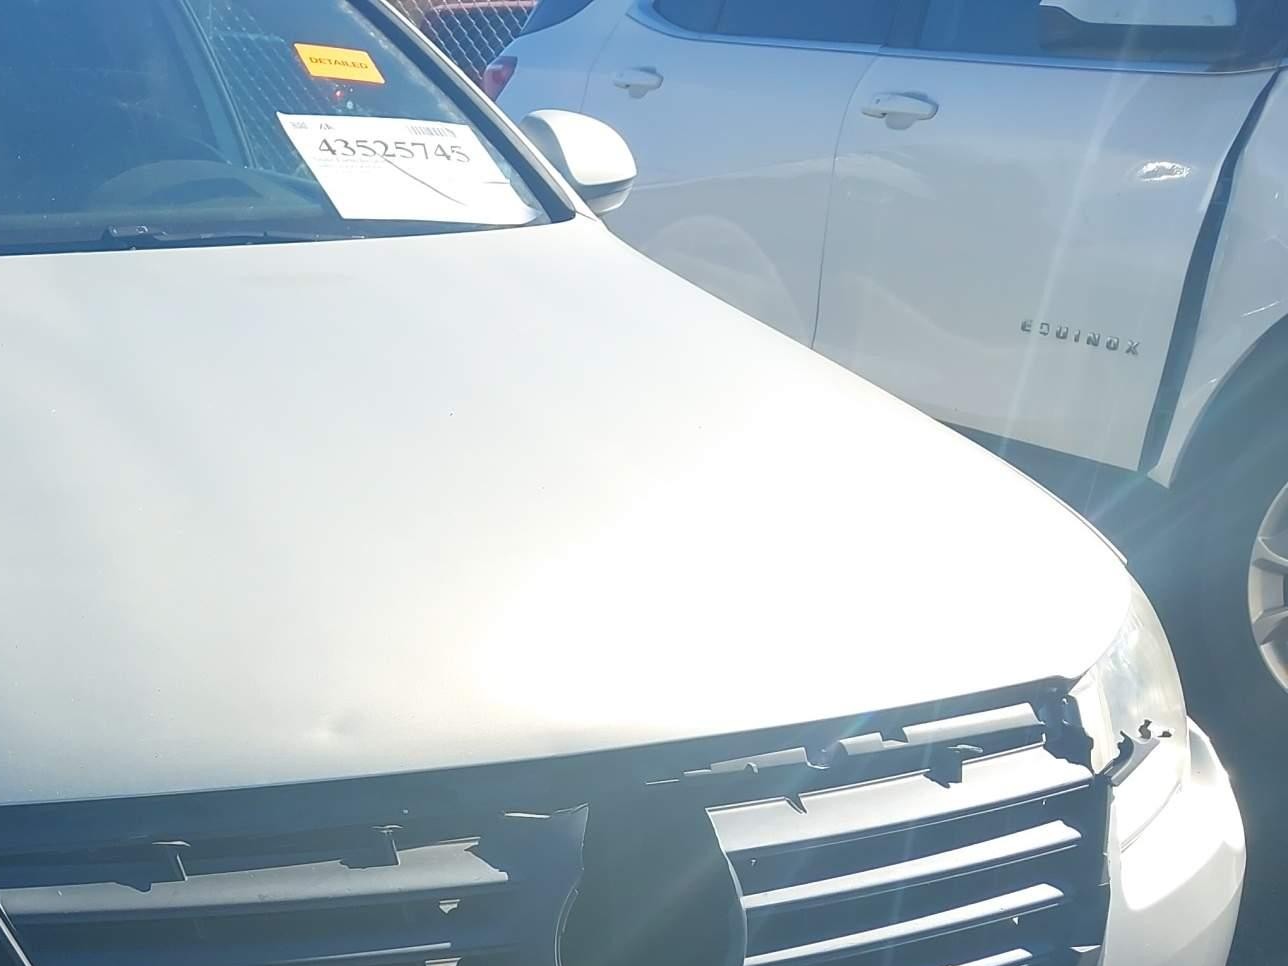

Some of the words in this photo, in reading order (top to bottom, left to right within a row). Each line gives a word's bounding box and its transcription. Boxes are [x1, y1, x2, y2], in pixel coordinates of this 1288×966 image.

[309, 56, 369, 70] DETAILED
[318, 138, 471, 163] 43525745
[1020, 319, 1141, 356] EQUINOX
